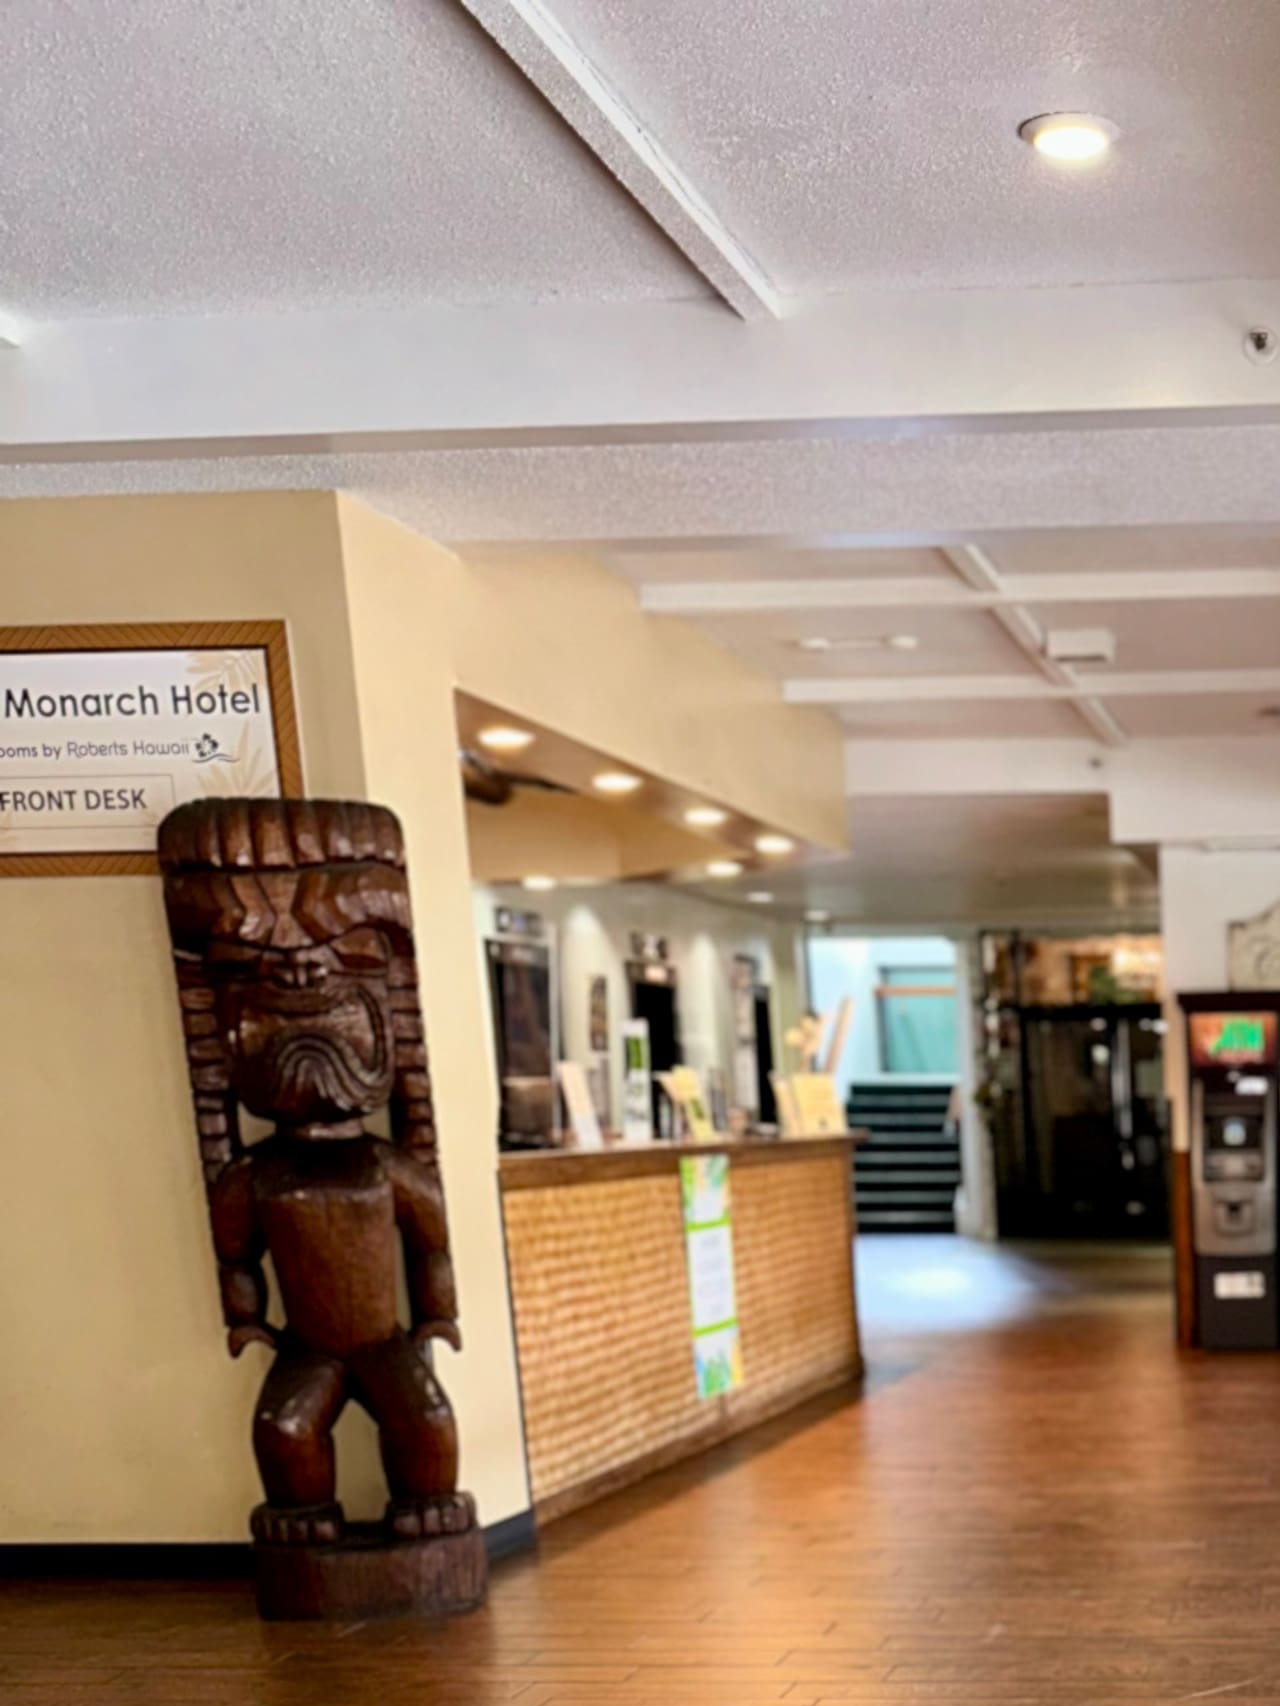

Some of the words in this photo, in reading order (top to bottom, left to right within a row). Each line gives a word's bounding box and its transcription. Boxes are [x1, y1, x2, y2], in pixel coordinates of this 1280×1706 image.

[4, 685, 159, 718] Monarch
[170, 683, 261, 714] Hotel
[42, 743, 62, 760] by
[67, 740, 128, 758] Roberts
[133, 740, 190, 756] Hawaii
[0, 790, 77, 812] FRONT
[84, 789, 147, 810] DESK
